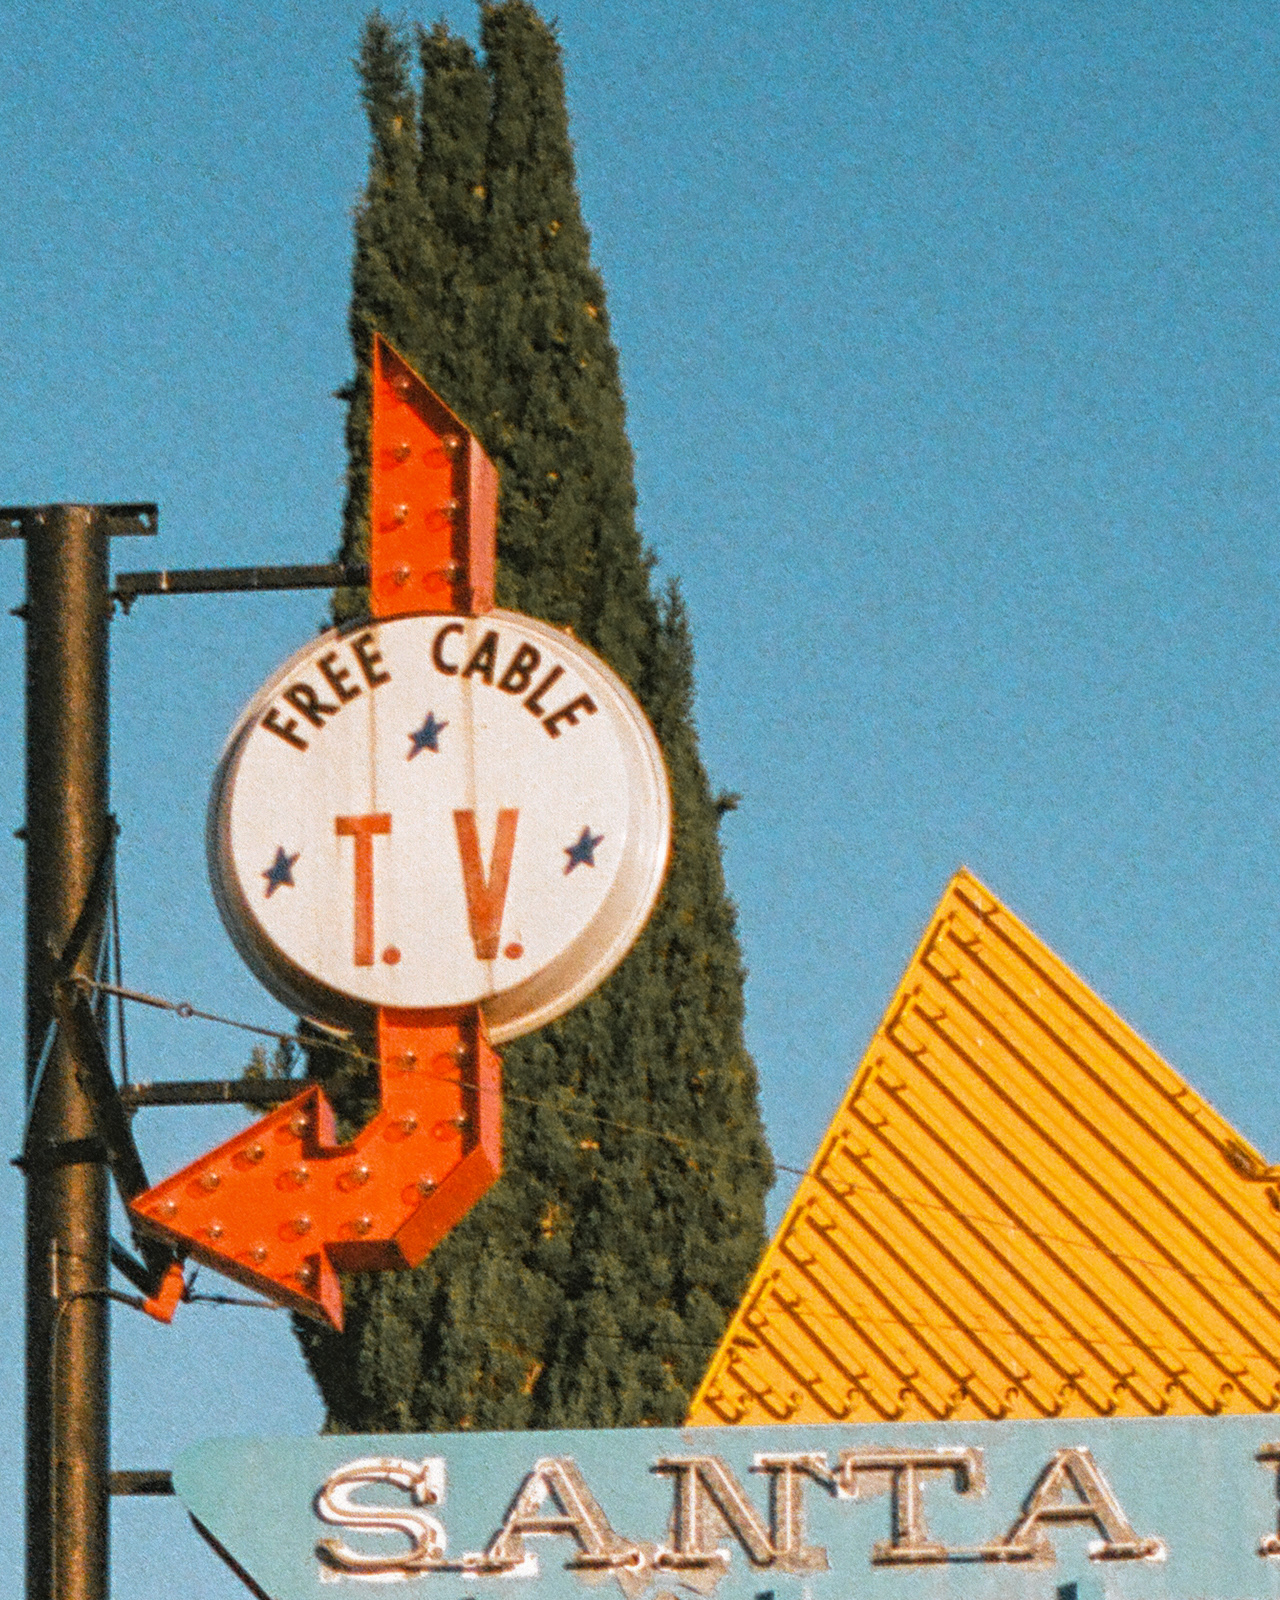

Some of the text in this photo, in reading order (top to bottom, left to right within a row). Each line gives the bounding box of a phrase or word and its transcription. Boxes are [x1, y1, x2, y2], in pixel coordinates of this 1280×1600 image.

[261, 622, 599, 752] FREE CABLE
[315, 1444, 1168, 1582] SANTA
